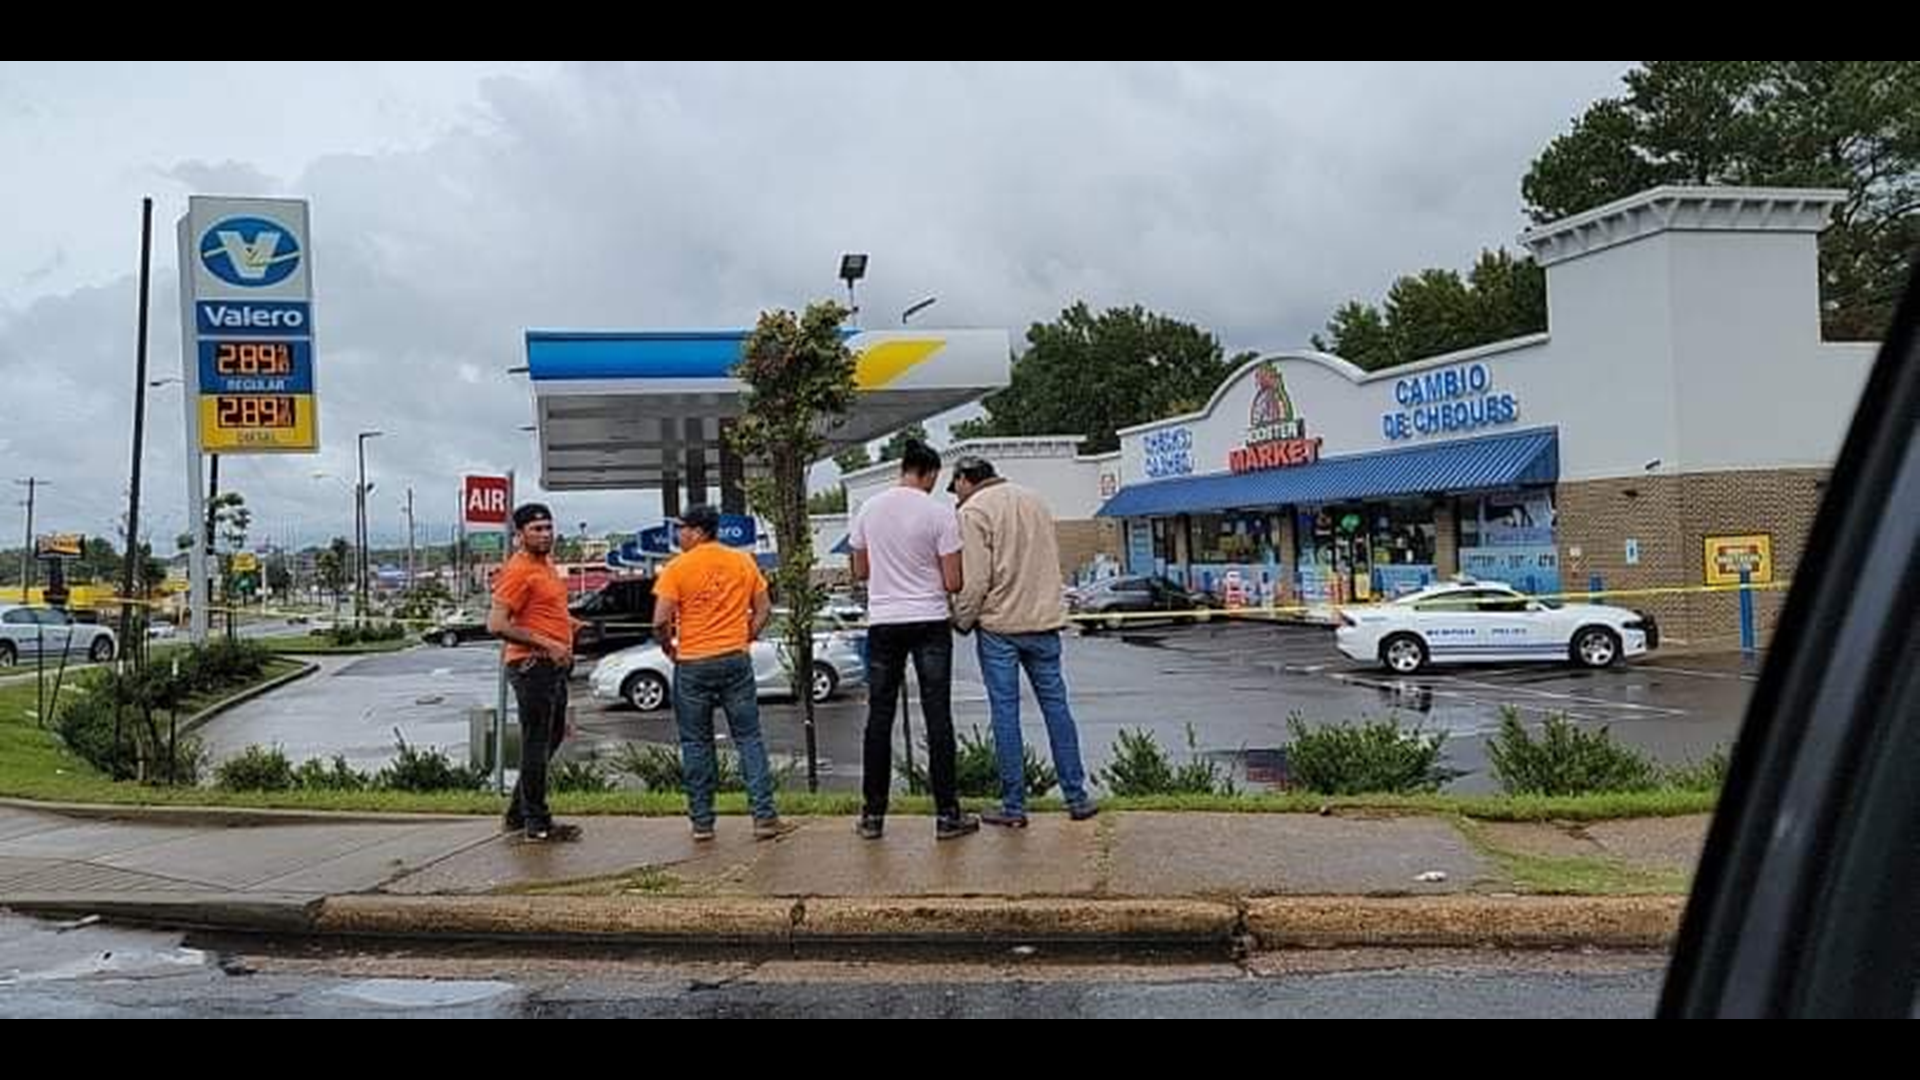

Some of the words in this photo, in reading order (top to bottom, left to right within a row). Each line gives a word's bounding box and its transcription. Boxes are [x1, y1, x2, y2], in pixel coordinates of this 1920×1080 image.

[205, 306, 303, 327] Valero
[227, 379, 285, 391] REGULAR
[1395, 364, 1487, 406] CAMBIO
[1383, 413, 1411, 441] DE
[1413, 394, 1515, 434] CHEQUES
[1228, 438, 1320, 476] MARKET
[468, 488, 505, 512] AIR
